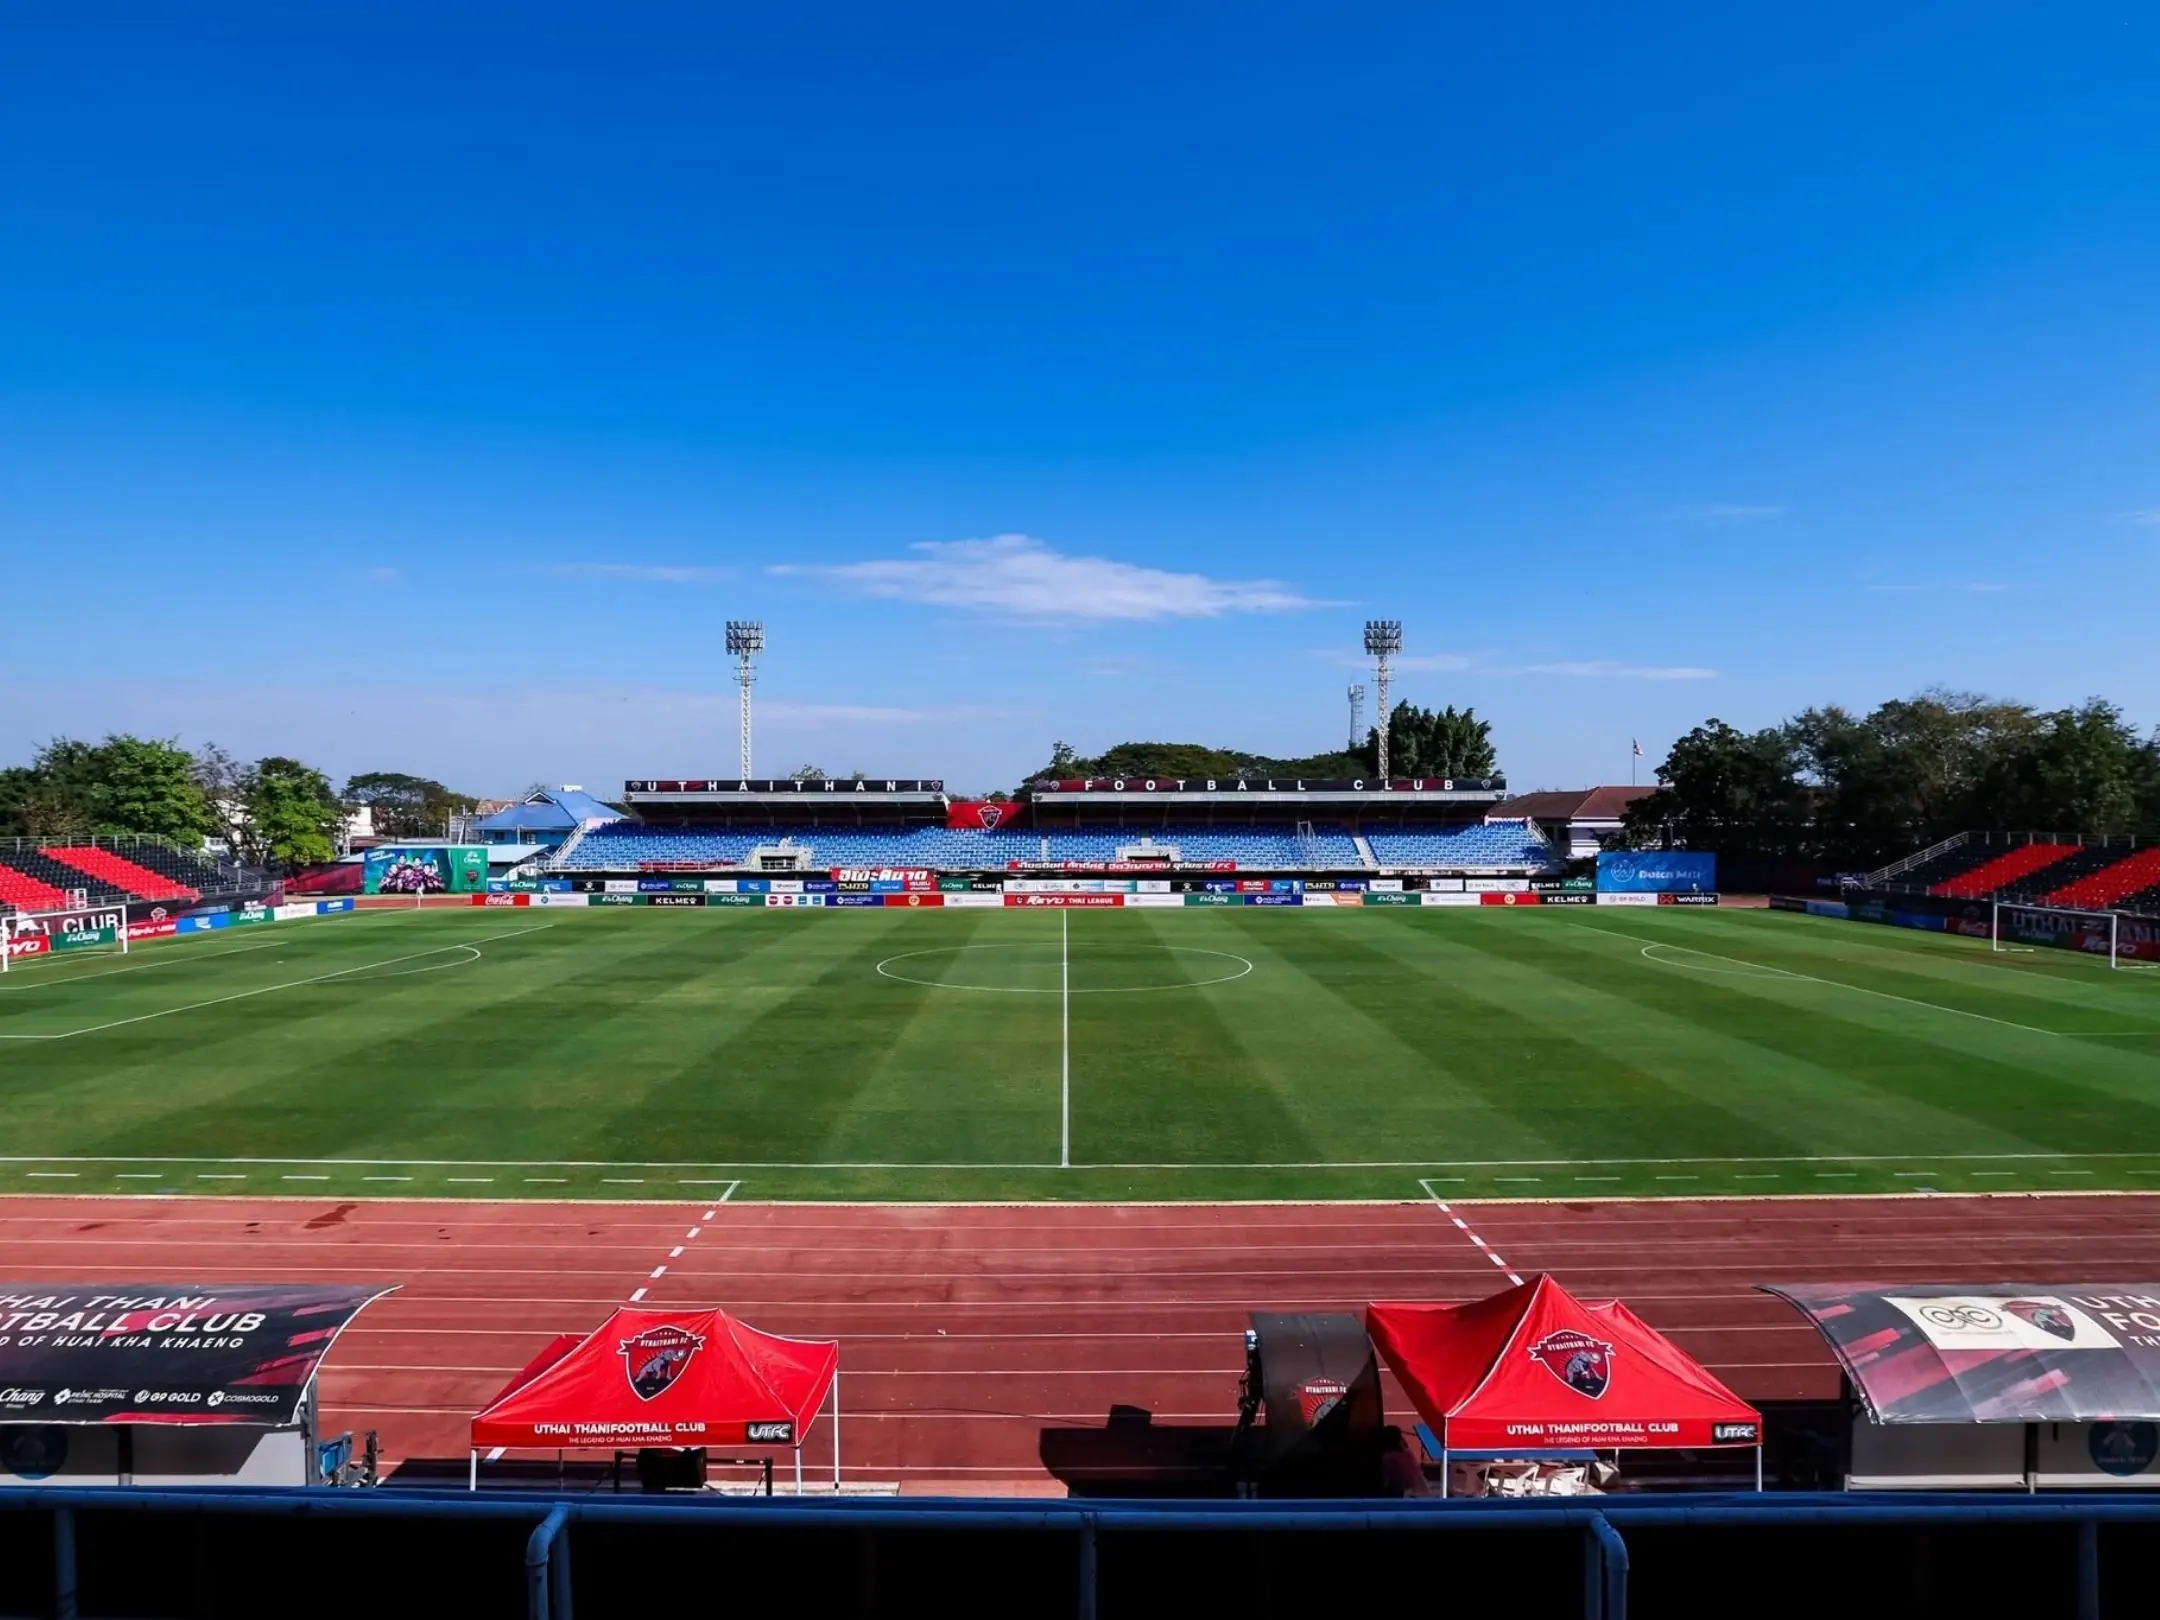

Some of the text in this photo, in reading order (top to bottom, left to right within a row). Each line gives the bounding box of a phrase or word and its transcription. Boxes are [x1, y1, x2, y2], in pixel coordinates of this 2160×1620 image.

[1084, 780, 1454, 791] FOOTBALL CLUB
[655, 896, 690, 904] KELME
[1547, 895, 1580, 903] KELME
[0, 1295, 217, 1310] HAI THANI
[0, 1312, 267, 1333] TBALL CLUB
[18, 1335, 48, 1347] OF
[51, 1335, 108, 1348] HUAI
[109, 1336, 152, 1348] KHA
[159, 1336, 244, 1349] KHAENG
[150, 1392, 201, 1402] G9 GOLD
[223, 1394, 279, 1403] COSMOGOLD
[534, 1423, 571, 1434] UTHAI
[675, 1422, 706, 1432] CLUB
[748, 1423, 791, 1439] UTFC
[1506, 1424, 1544, 1435] UTHAI
[1648, 1422, 1679, 1432] CLUB
[1714, 1425, 1756, 1439] UTFC
